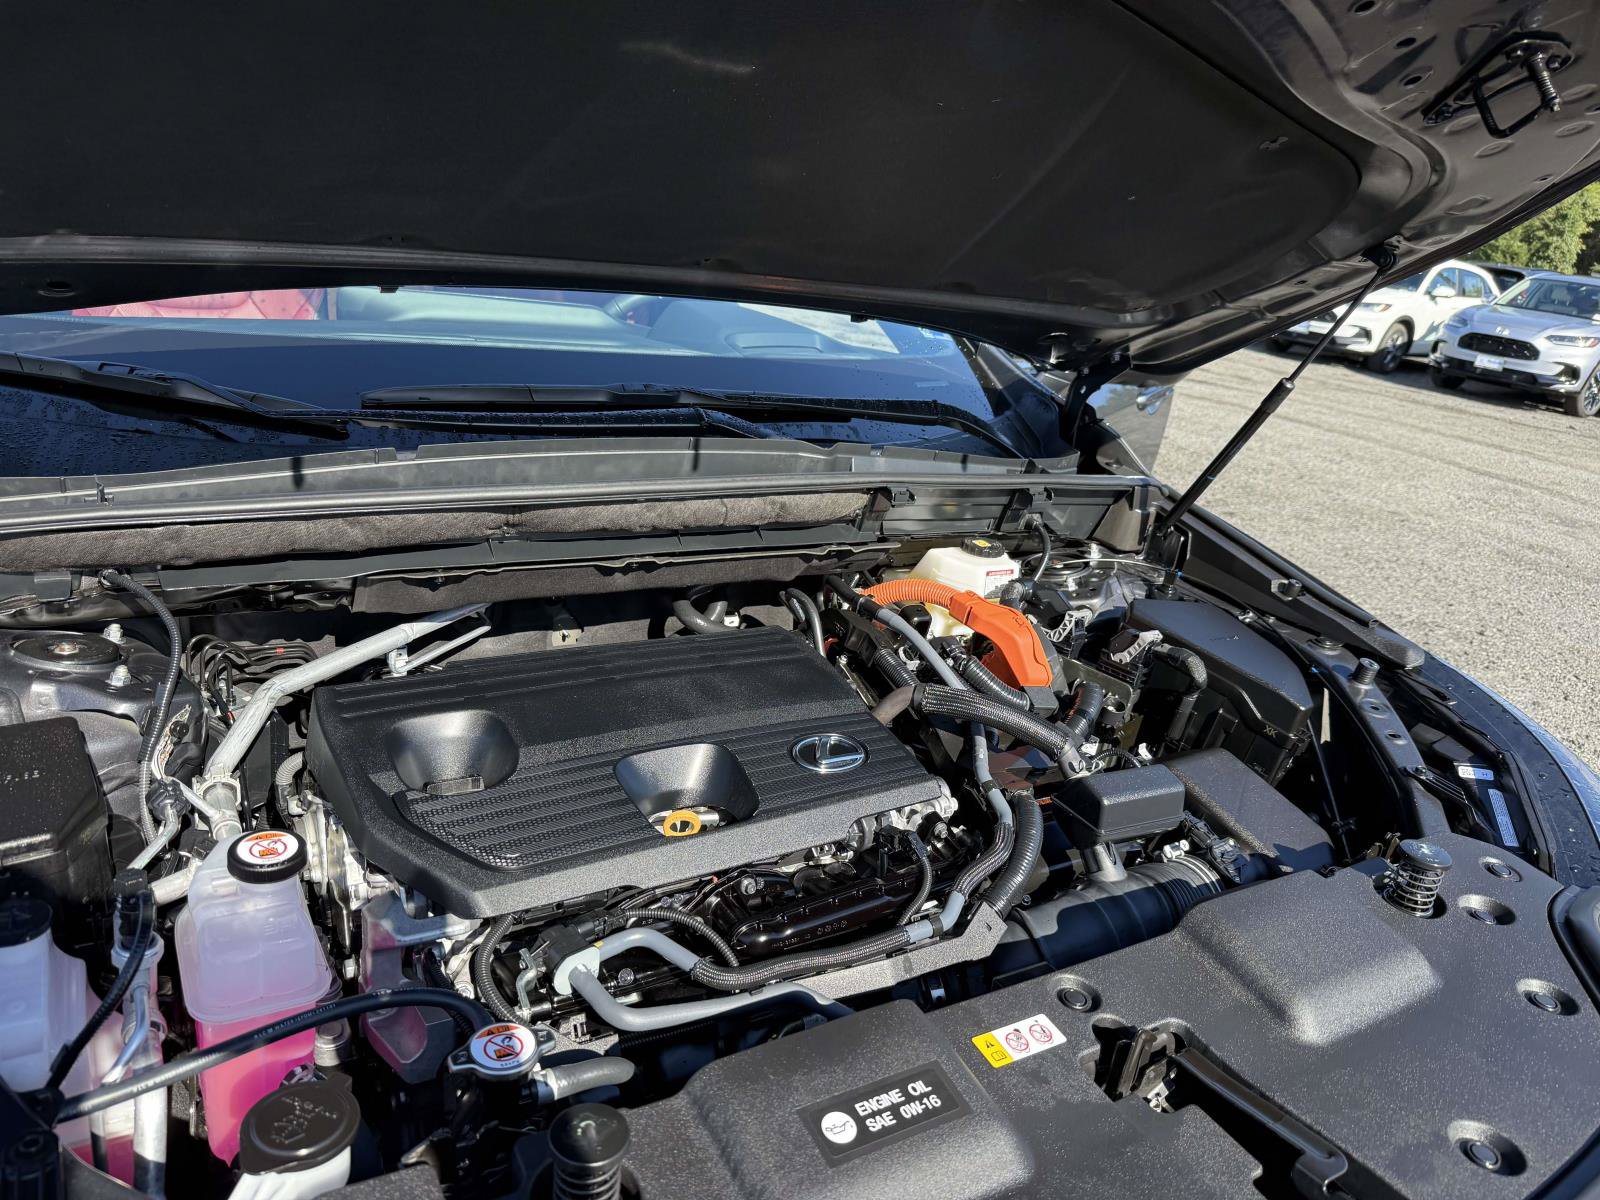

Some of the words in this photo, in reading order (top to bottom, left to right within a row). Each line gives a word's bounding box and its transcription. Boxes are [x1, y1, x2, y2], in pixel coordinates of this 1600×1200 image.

[854, 1088, 905, 1116] ENGINE
[907, 1080, 932, 1096] OIL
[865, 1111, 897, 1132] SAE
[900, 1094, 941, 1119] 0W-16
